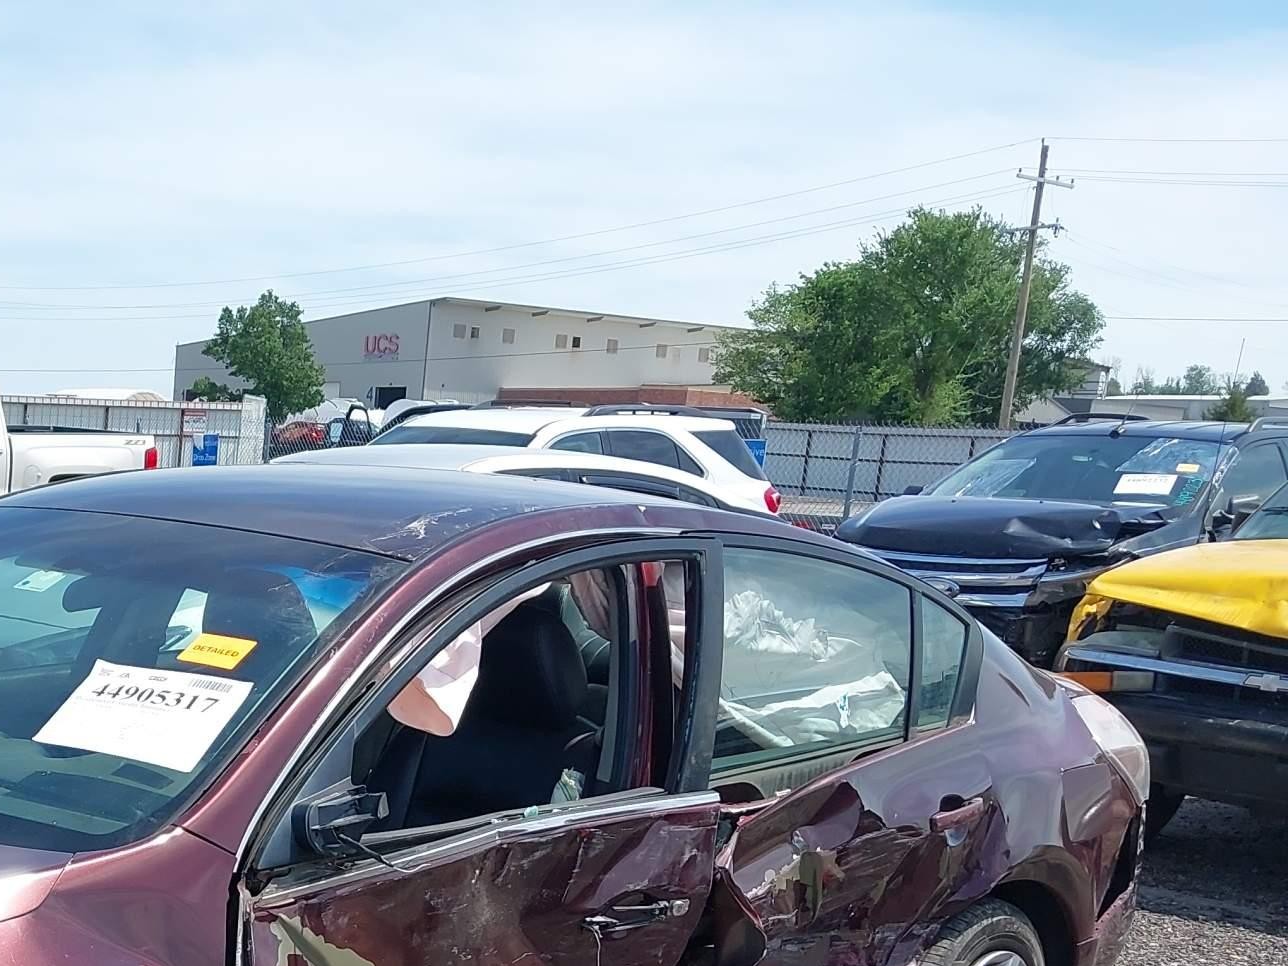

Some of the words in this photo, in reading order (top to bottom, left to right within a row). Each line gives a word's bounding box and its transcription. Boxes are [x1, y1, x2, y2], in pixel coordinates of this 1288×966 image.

[364, 334, 399, 353] UCS
[192, 644, 240, 657] DETAILED
[92, 684, 220, 713] 44905317
